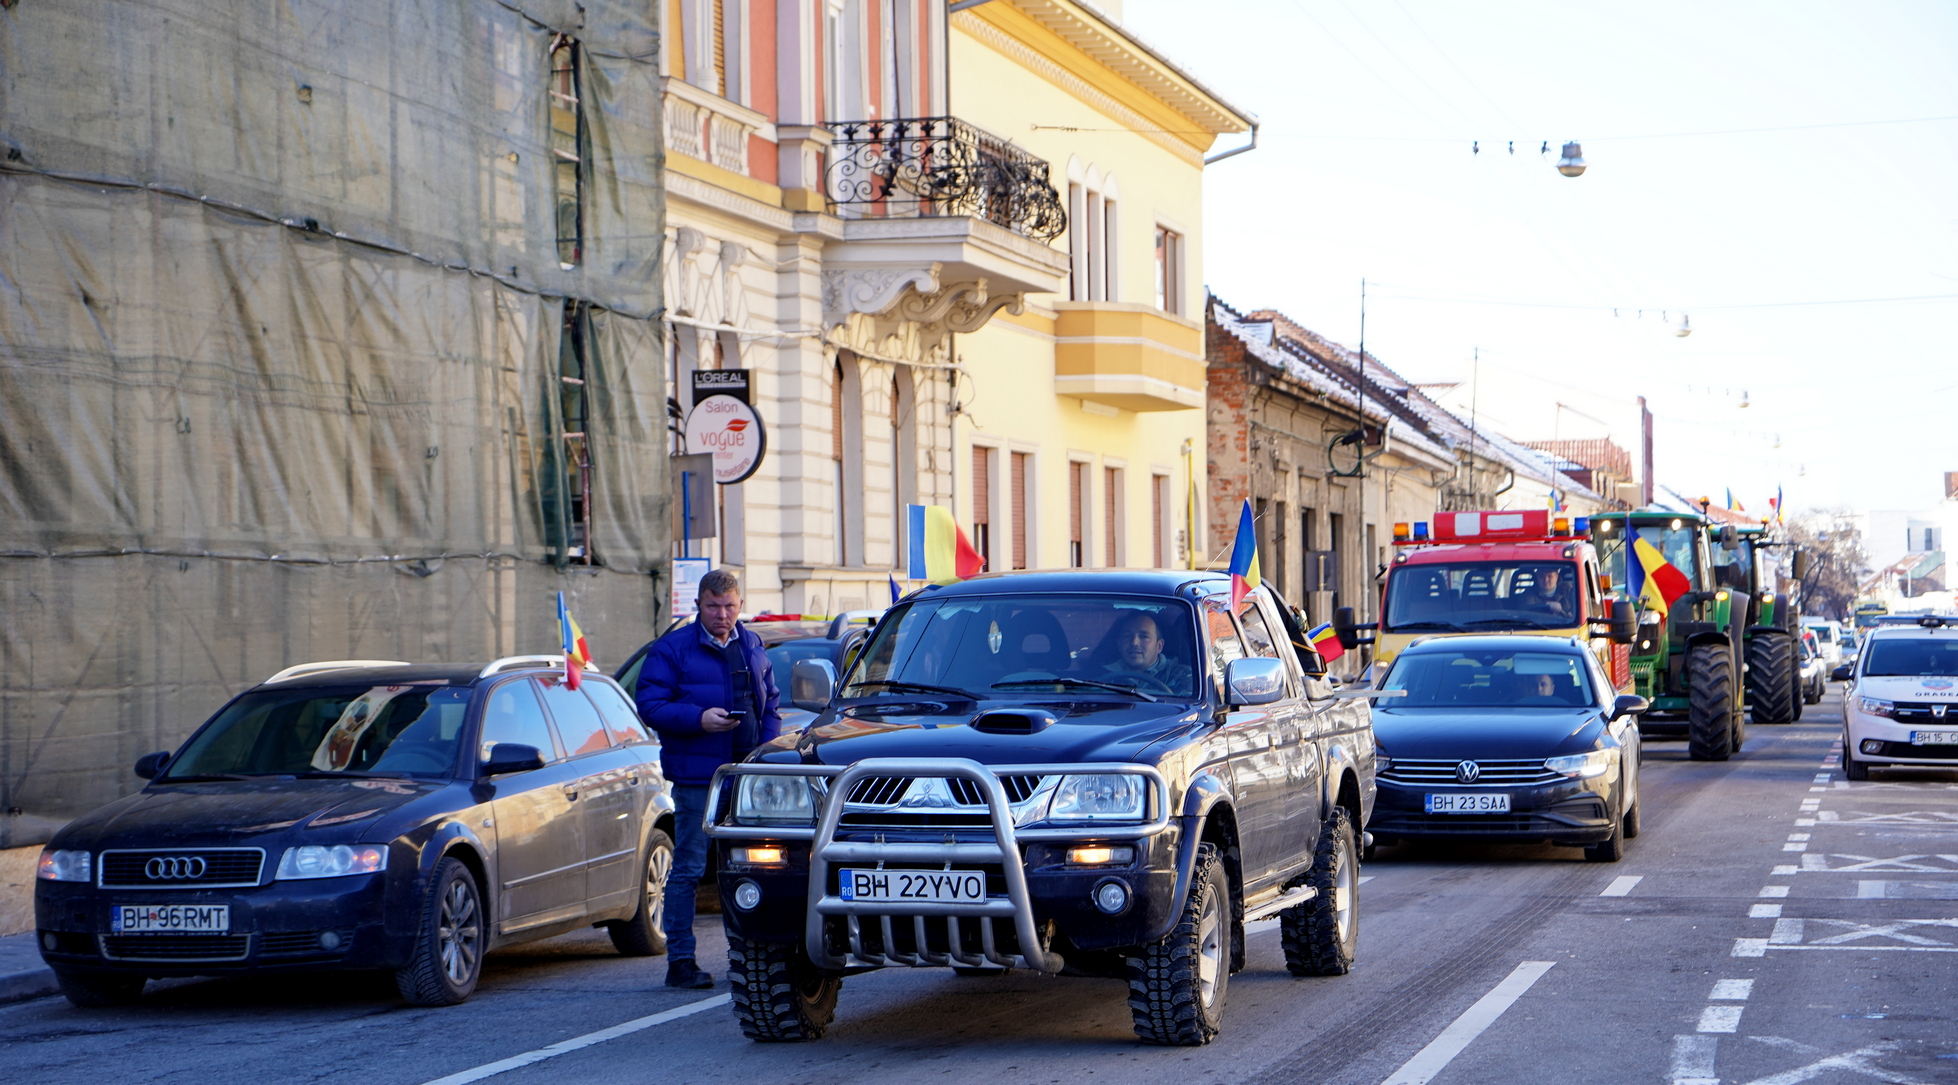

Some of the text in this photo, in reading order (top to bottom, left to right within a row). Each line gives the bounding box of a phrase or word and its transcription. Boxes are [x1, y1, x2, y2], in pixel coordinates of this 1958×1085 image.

[705, 401, 739, 414] Salon
[714, 451, 734, 459] enter
[1917, 732, 1930, 742] BH
[1933, 732, 1943, 742] 15
[1950, 732, 1958, 742] C
[1433, 796, 1454, 810] BH
[1459, 796, 1476, 810] 23
[1480, 796, 1507, 810] SAA
[854, 873, 890, 898] BH
[123, 907, 150, 929] BH
